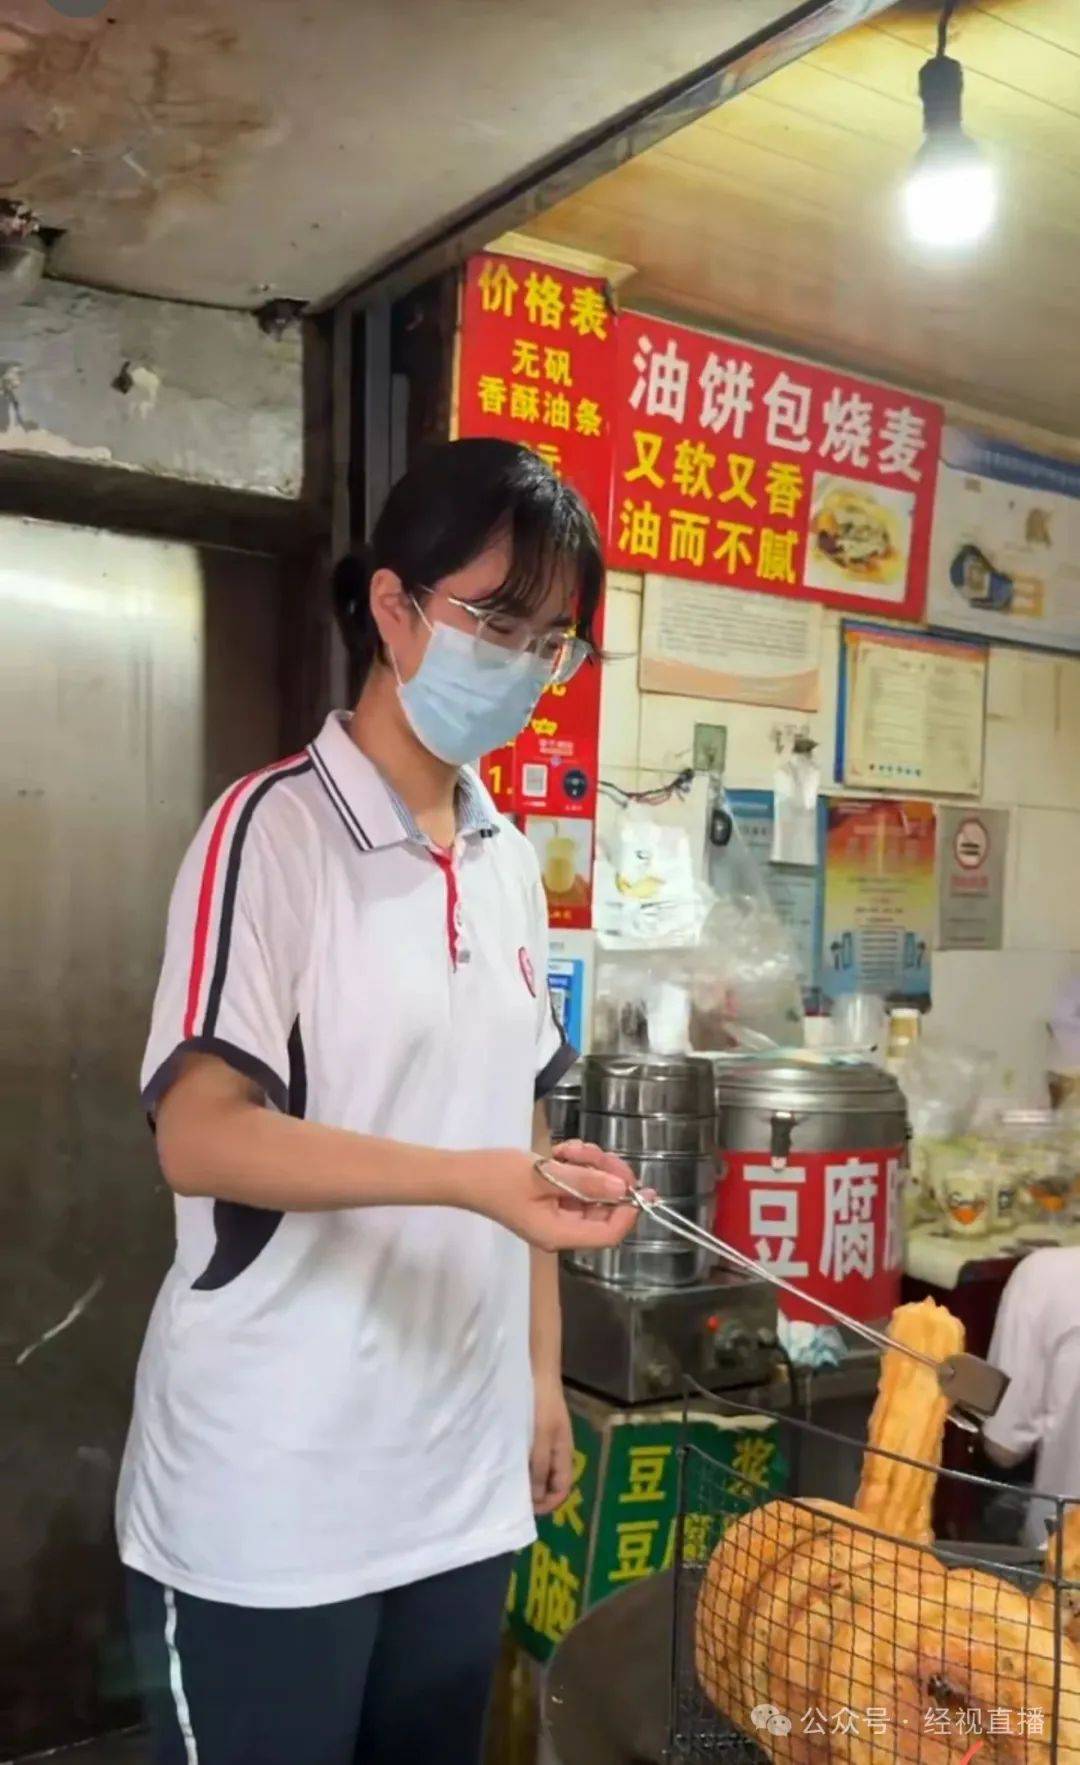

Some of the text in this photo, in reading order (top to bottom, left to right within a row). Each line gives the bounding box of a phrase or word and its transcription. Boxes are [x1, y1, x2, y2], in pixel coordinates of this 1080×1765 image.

[478, 260, 608, 341] 价格表
[511, 339, 573, 387] 无矾
[477, 375, 602, 437] 香酥油条
[628, 334, 926, 482] 油饼包烧麦
[624, 430, 804, 519] 又软又香
[618, 499, 799, 584] 油而不腻
[608, 1511, 739, 1581] 豆腐
